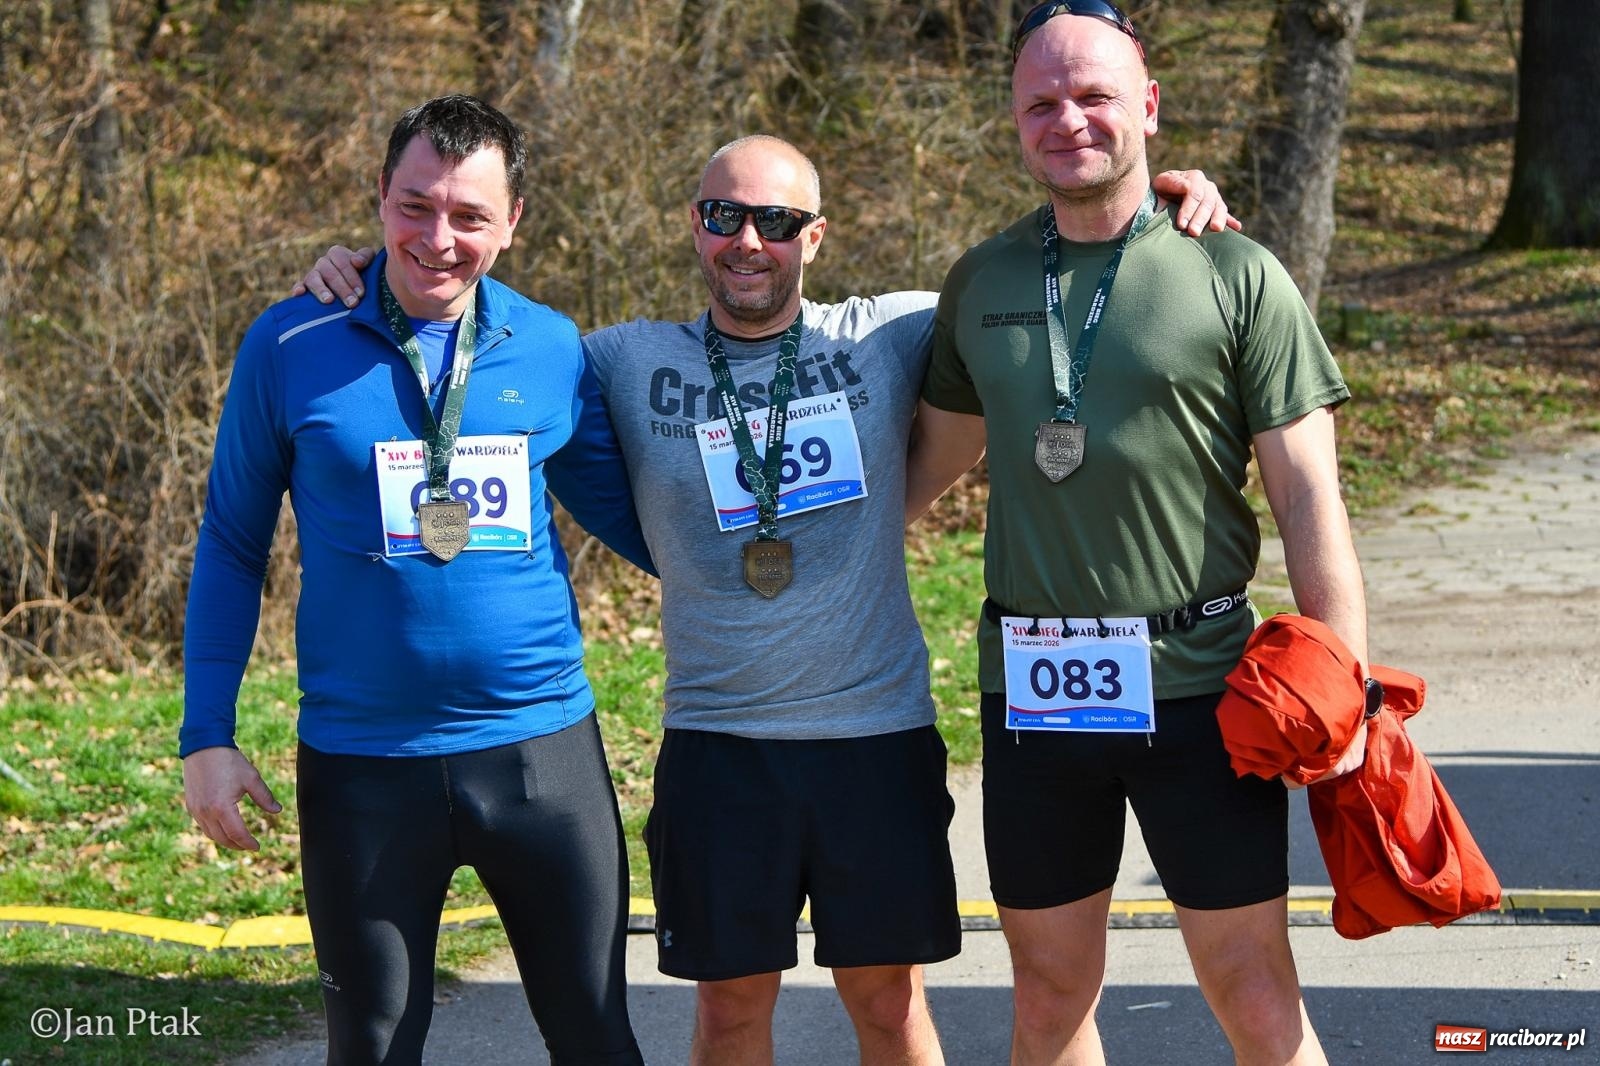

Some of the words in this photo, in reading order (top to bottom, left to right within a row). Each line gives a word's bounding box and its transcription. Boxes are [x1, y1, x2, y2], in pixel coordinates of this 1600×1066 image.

[651, 420, 697, 439] FORG
[707, 427, 727, 441] XIV
[388, 450, 408, 461] XIV
[456, 444, 518, 457] WARDZIELA
[1012, 626, 1029, 636] XIV
[1037, 627, 1059, 638] IEG
[1030, 658, 1122, 700] 083
